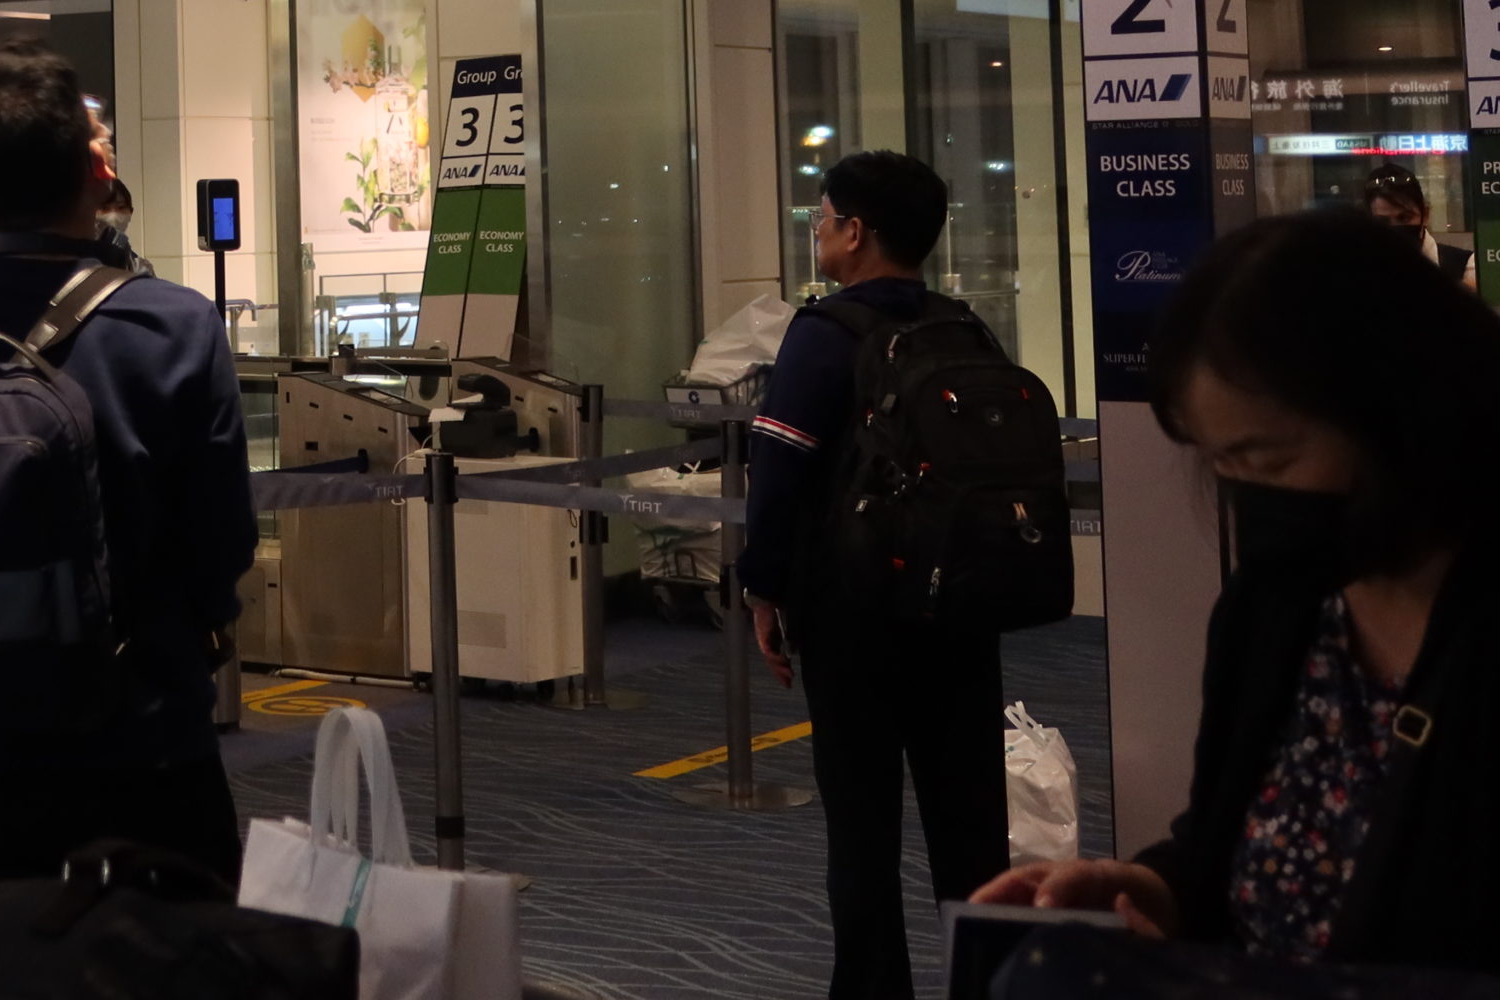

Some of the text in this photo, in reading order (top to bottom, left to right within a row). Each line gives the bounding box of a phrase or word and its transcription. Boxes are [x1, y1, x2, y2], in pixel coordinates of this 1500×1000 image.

[457, 68, 497, 85] Group
[1093, 78, 1157, 104] ANA
[1211, 76, 1235, 101] ANA
[455, 107, 480, 147] 3
[503, 104, 524, 144] 3
[1092, 122, 1115, 130] STAR
[1116, 120, 1159, 129] ALLIANCE
[489, 164, 518, 177] ANA
[1100, 154, 1191, 172] BUSINESS
[1215, 153, 1249, 171] BUSINESS
[442, 166, 469, 179] ANA
[1116, 179, 1176, 197] CLASS
[1222, 179, 1245, 196] CLASS
[433, 231, 471, 243] ECONOMY
[479, 230, 524, 241] ECONOMY
[438, 244, 462, 254] CLASS
[485, 243, 514, 253] CLASS
[1114, 250, 1182, 282] Platinum
[374, 484, 404, 497] TIAT
[628, 499, 662, 514] TIAT
